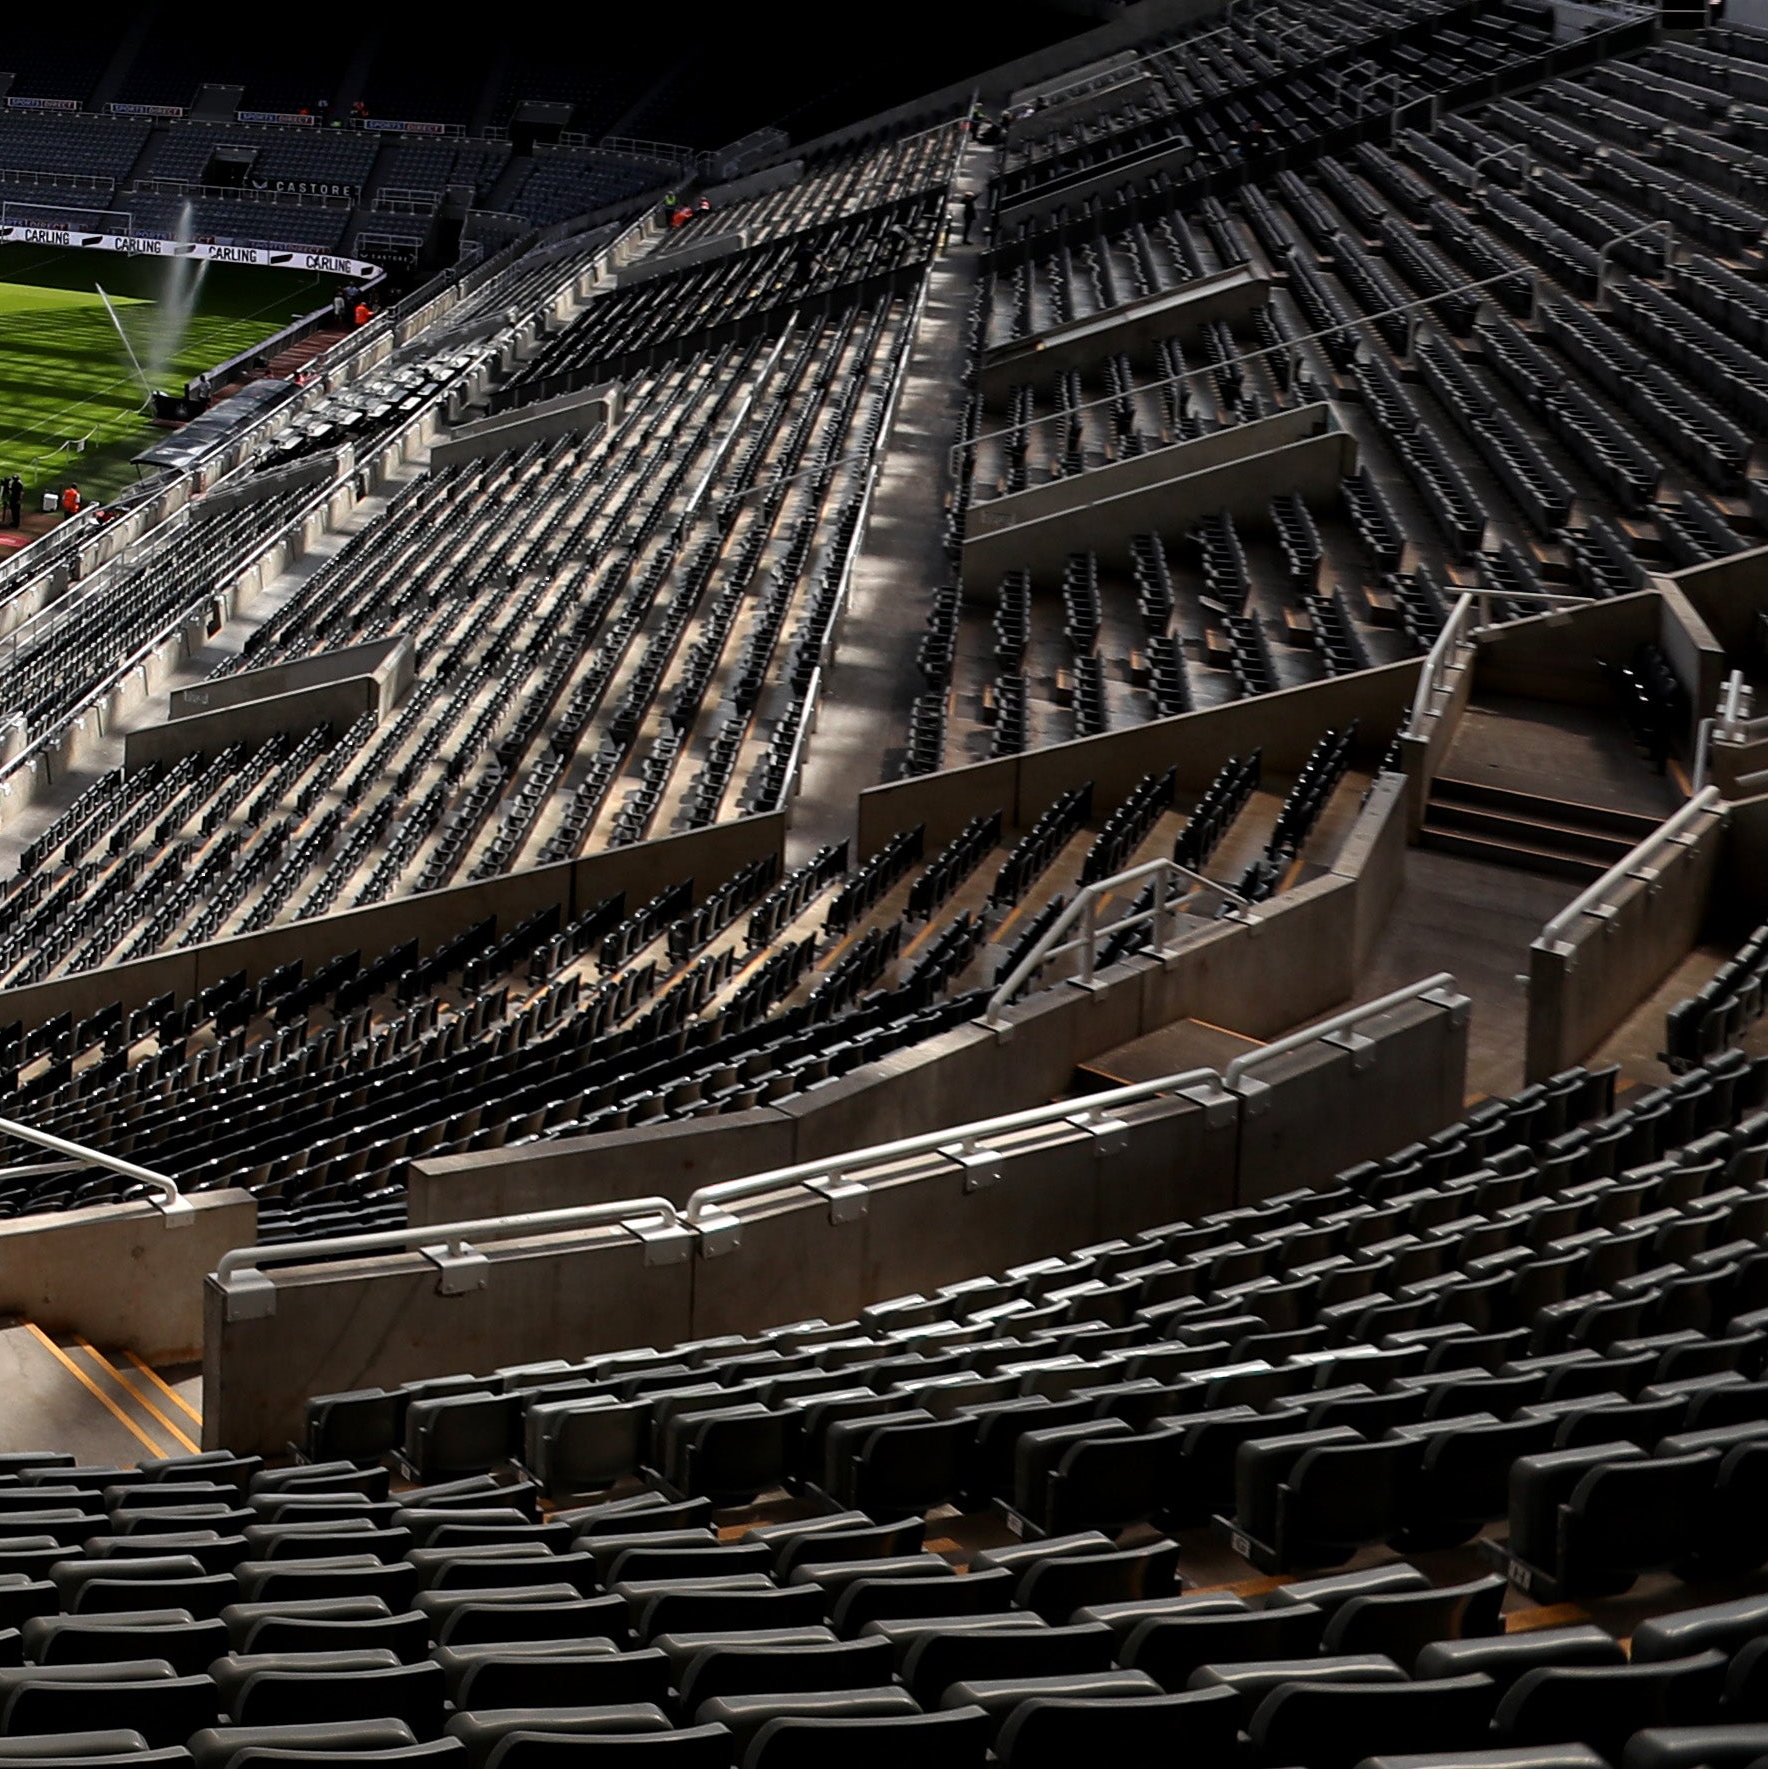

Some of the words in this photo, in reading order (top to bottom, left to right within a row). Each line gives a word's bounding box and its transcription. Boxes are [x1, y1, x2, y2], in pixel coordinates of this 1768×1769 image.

[147, 106, 180, 116] DIRECT
[240, 112, 275, 122] SPORTS
[277, 114, 313, 124] DIRECT
[366, 120, 403, 130] SPORTS
[406, 122, 442, 132] DIRECT
[276, 181, 351, 196] CASTORE
[25, 229, 70, 245] CARLING
[115, 237, 161, 253] CARLING
[209, 246, 257, 263] CARLING
[306, 255, 352, 273] CARLING
